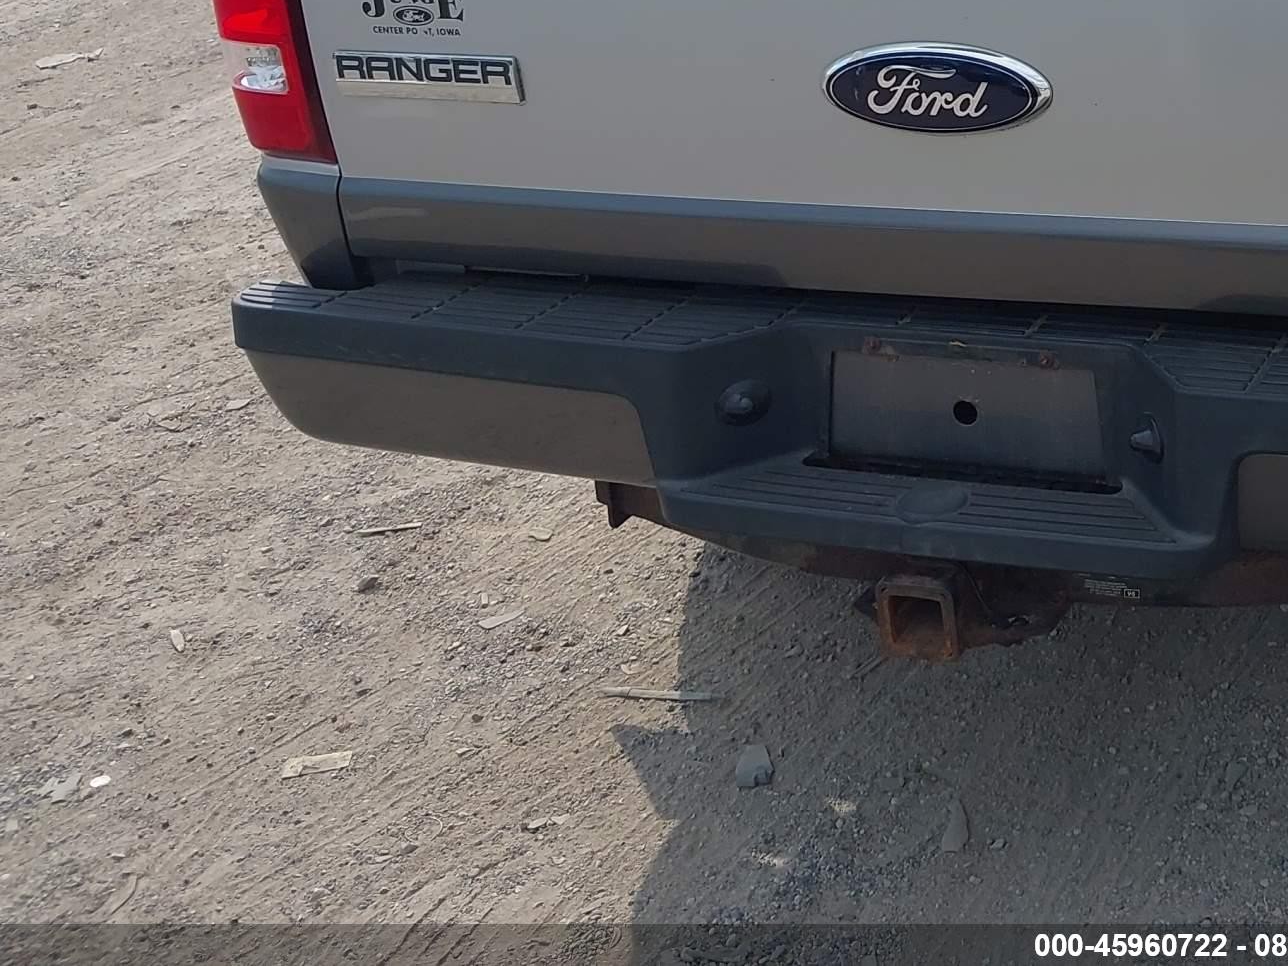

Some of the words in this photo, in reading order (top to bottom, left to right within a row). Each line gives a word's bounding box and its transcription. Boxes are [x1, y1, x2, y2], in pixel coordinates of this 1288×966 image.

[372, 26, 404, 35] CENTER
[436, 28, 461, 36] IOWA
[335, 55, 513, 85] RANGER
[867, 65, 988, 118] Ford
